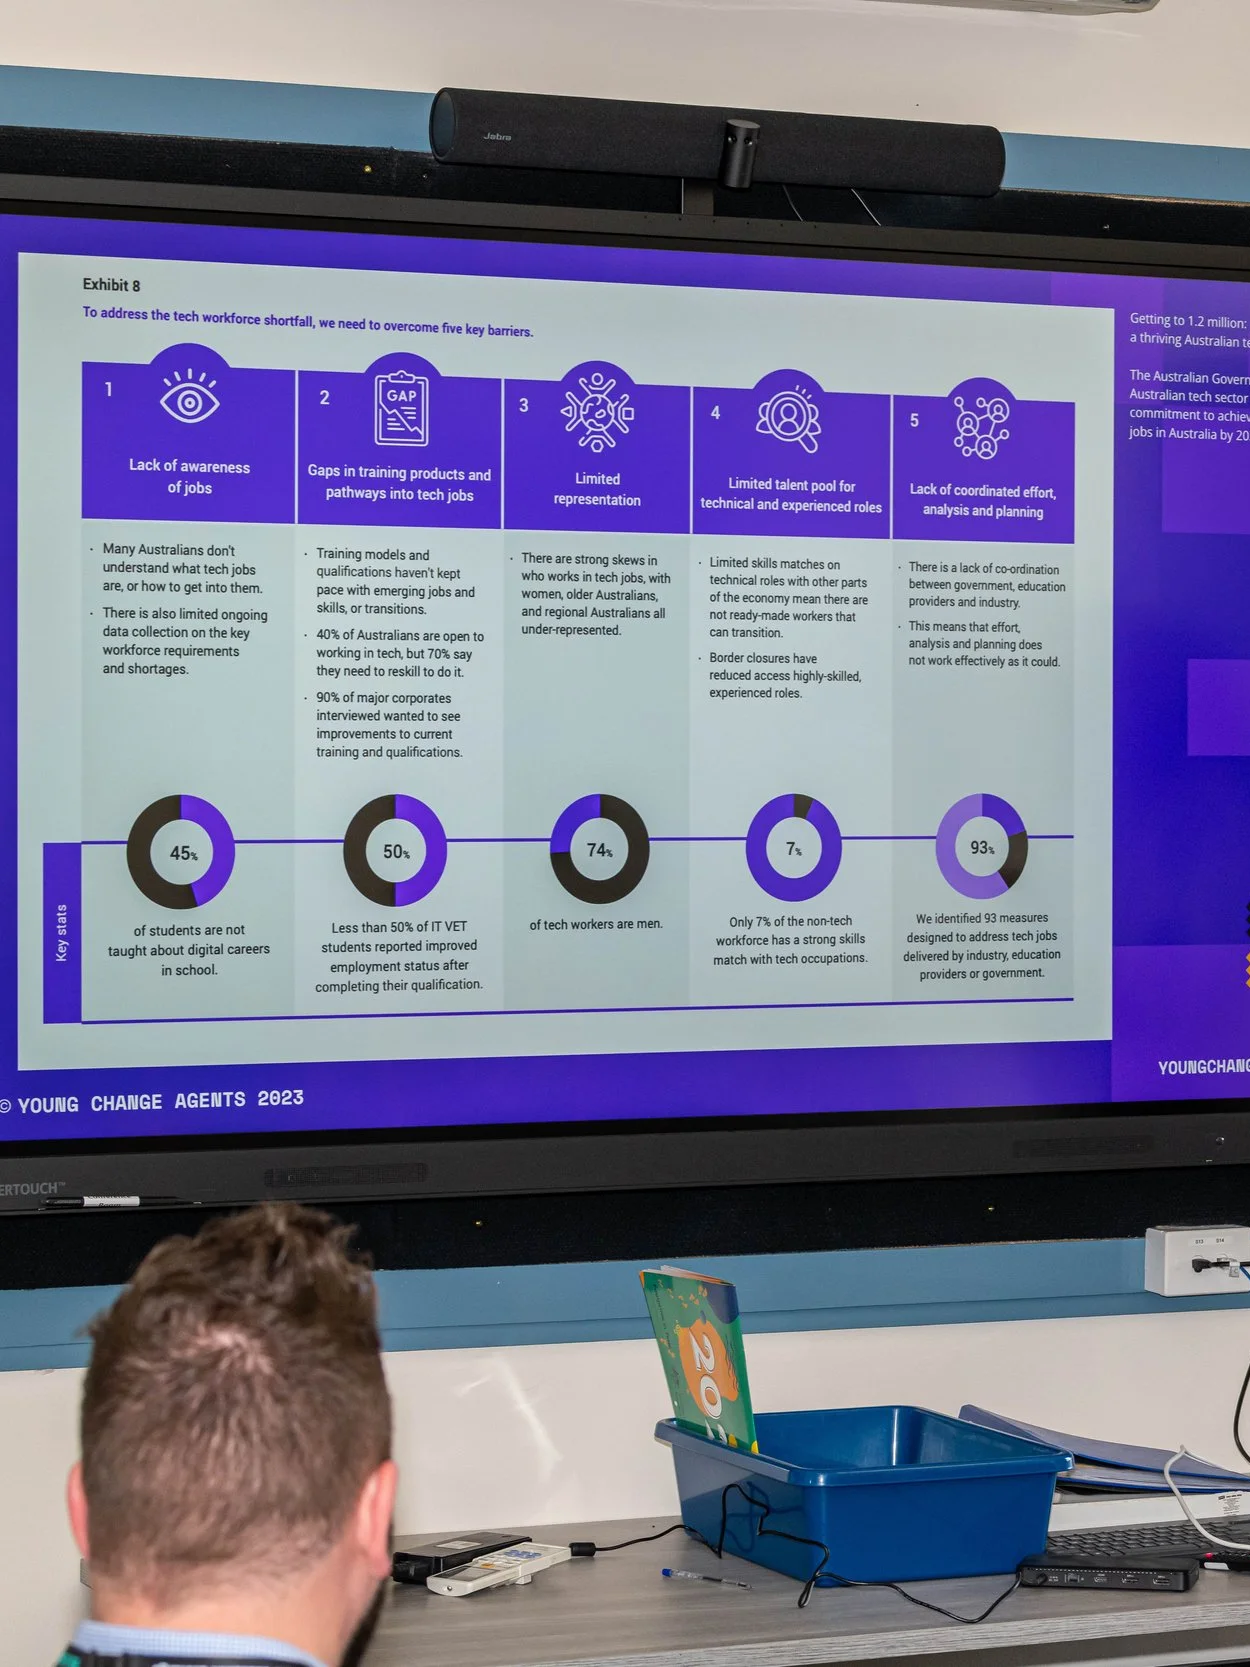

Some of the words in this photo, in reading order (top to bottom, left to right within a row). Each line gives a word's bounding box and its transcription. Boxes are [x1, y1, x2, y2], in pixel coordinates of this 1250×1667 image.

[483, 132, 512, 141] Jabra
[83, 277, 129, 292] Exhibit
[132, 279, 140, 292] 8
[82, 305, 98, 318] To
[100, 306, 148, 320] address
[150, 308, 170, 321] the
[172, 310, 199, 322] tech
[202, 311, 261, 325] workforce
[264, 313, 316, 329] shortfall,
[318, 319, 336, 328] we
[338, 318, 366, 330] need
[368, 319, 381, 331] to
[383, 322, 439, 333] overcome
[441, 322, 462, 334] five
[465, 322, 485, 338] key
[487, 323, 534, 337] barriers.
[1130, 312, 1171, 328] Getting
[1173, 315, 1185, 326] to
[1188, 315, 1204, 327] 1.2
[1207, 316, 1247, 329] million:
[1129, 333, 1137, 343] a
[1139, 331, 1182, 348] thriving
[1184, 334, 1240, 347] Australian
[1129, 368, 1151, 381] The
[1152, 370, 1209, 383] Australian
[105, 381, 112, 397] 1
[386, 390, 417, 402] GAP
[1129, 387, 1186, 401] Australian
[1188, 390, 1212, 402] tech
[1214, 393, 1249, 404] sector
[320, 390, 329, 405] 2
[519, 398, 528, 413] 3
[711, 406, 720, 420] 4
[910, 414, 919, 427] 5
[1129, 407, 1201, 420] commitment
[1203, 411, 1215, 421] to
[1128, 425, 1153, 440] jobs
[1155, 426, 1166, 438] in
[1168, 427, 1217, 440] Australia
[1220, 428, 1234, 443] by
[129, 458, 161, 471] Lack
[163, 458, 178, 471] of
[180, 462, 250, 474] awareness
[307, 463, 340, 479] Gaps
[344, 467, 356, 477] in
[358, 465, 406, 482] training
[410, 467, 465, 482] products
[468, 468, 491, 481] and
[575, 471, 620, 485] Limited
[728, 477, 772, 490] Limited
[774, 478, 808, 491] talent
[811, 479, 836, 494] pool
[838, 479, 856, 492] for
[167, 480, 182, 493] of
[183, 480, 212, 497] jobs
[326, 485, 386, 502] pathways
[390, 488, 414, 500] into
[416, 488, 444, 501] tech
[446, 488, 474, 504] jobs
[910, 482, 937, 495] Lack
[939, 483, 952, 495] of
[953, 484, 1020, 497] coordinated
[1022, 485, 1056, 500] effort,
[554, 493, 641, 507] representation
[700, 496, 754, 509] technical
[756, 498, 779, 510] and
[781, 499, 851, 514] experienced
[854, 500, 882, 513] roles
[922, 503, 970, 518] analysis
[972, 504, 993, 516] and
[995, 504, 1044, 521] planning
[103, 542, 136, 557] Many
[138, 543, 204, 556] Australians
[206, 544, 235, 556] don't
[316, 547, 362, 562] Training
[364, 548, 406, 561] models
[408, 549, 430, 561] and
[521, 551, 552, 564] There
[554, 555, 572, 564] are
[574, 554, 609, 568] strong
[612, 553, 645, 566] skews
[647, 554, 658, 566] in
[710, 556, 748, 568] Limited
[751, 557, 778, 569] skills
[780, 558, 825, 570] matches
[827, 561, 840, 570] on
[908, 560, 938, 573] There
[940, 561, 949, 572] is
[950, 564, 957, 573] a
[959, 562, 980, 573] lack
[982, 562, 993, 574] of
[994, 563, 1060, 575] co-ordination
[57, 904, 67, 933] stats
[529, 918, 542, 930] of
[543, 918, 568, 930] tech
[570, 918, 614, 930] workers
[616, 920, 634, 929] are
[636, 920, 663, 929] men.
[56, 937, 68, 962] Key
[17, 1096, 78, 1114] YOUNG
[91, 1093, 162, 1111] CHANGE
[174, 1091, 246, 1109] AGENTS
[257, 1089, 304, 1106] 2023
